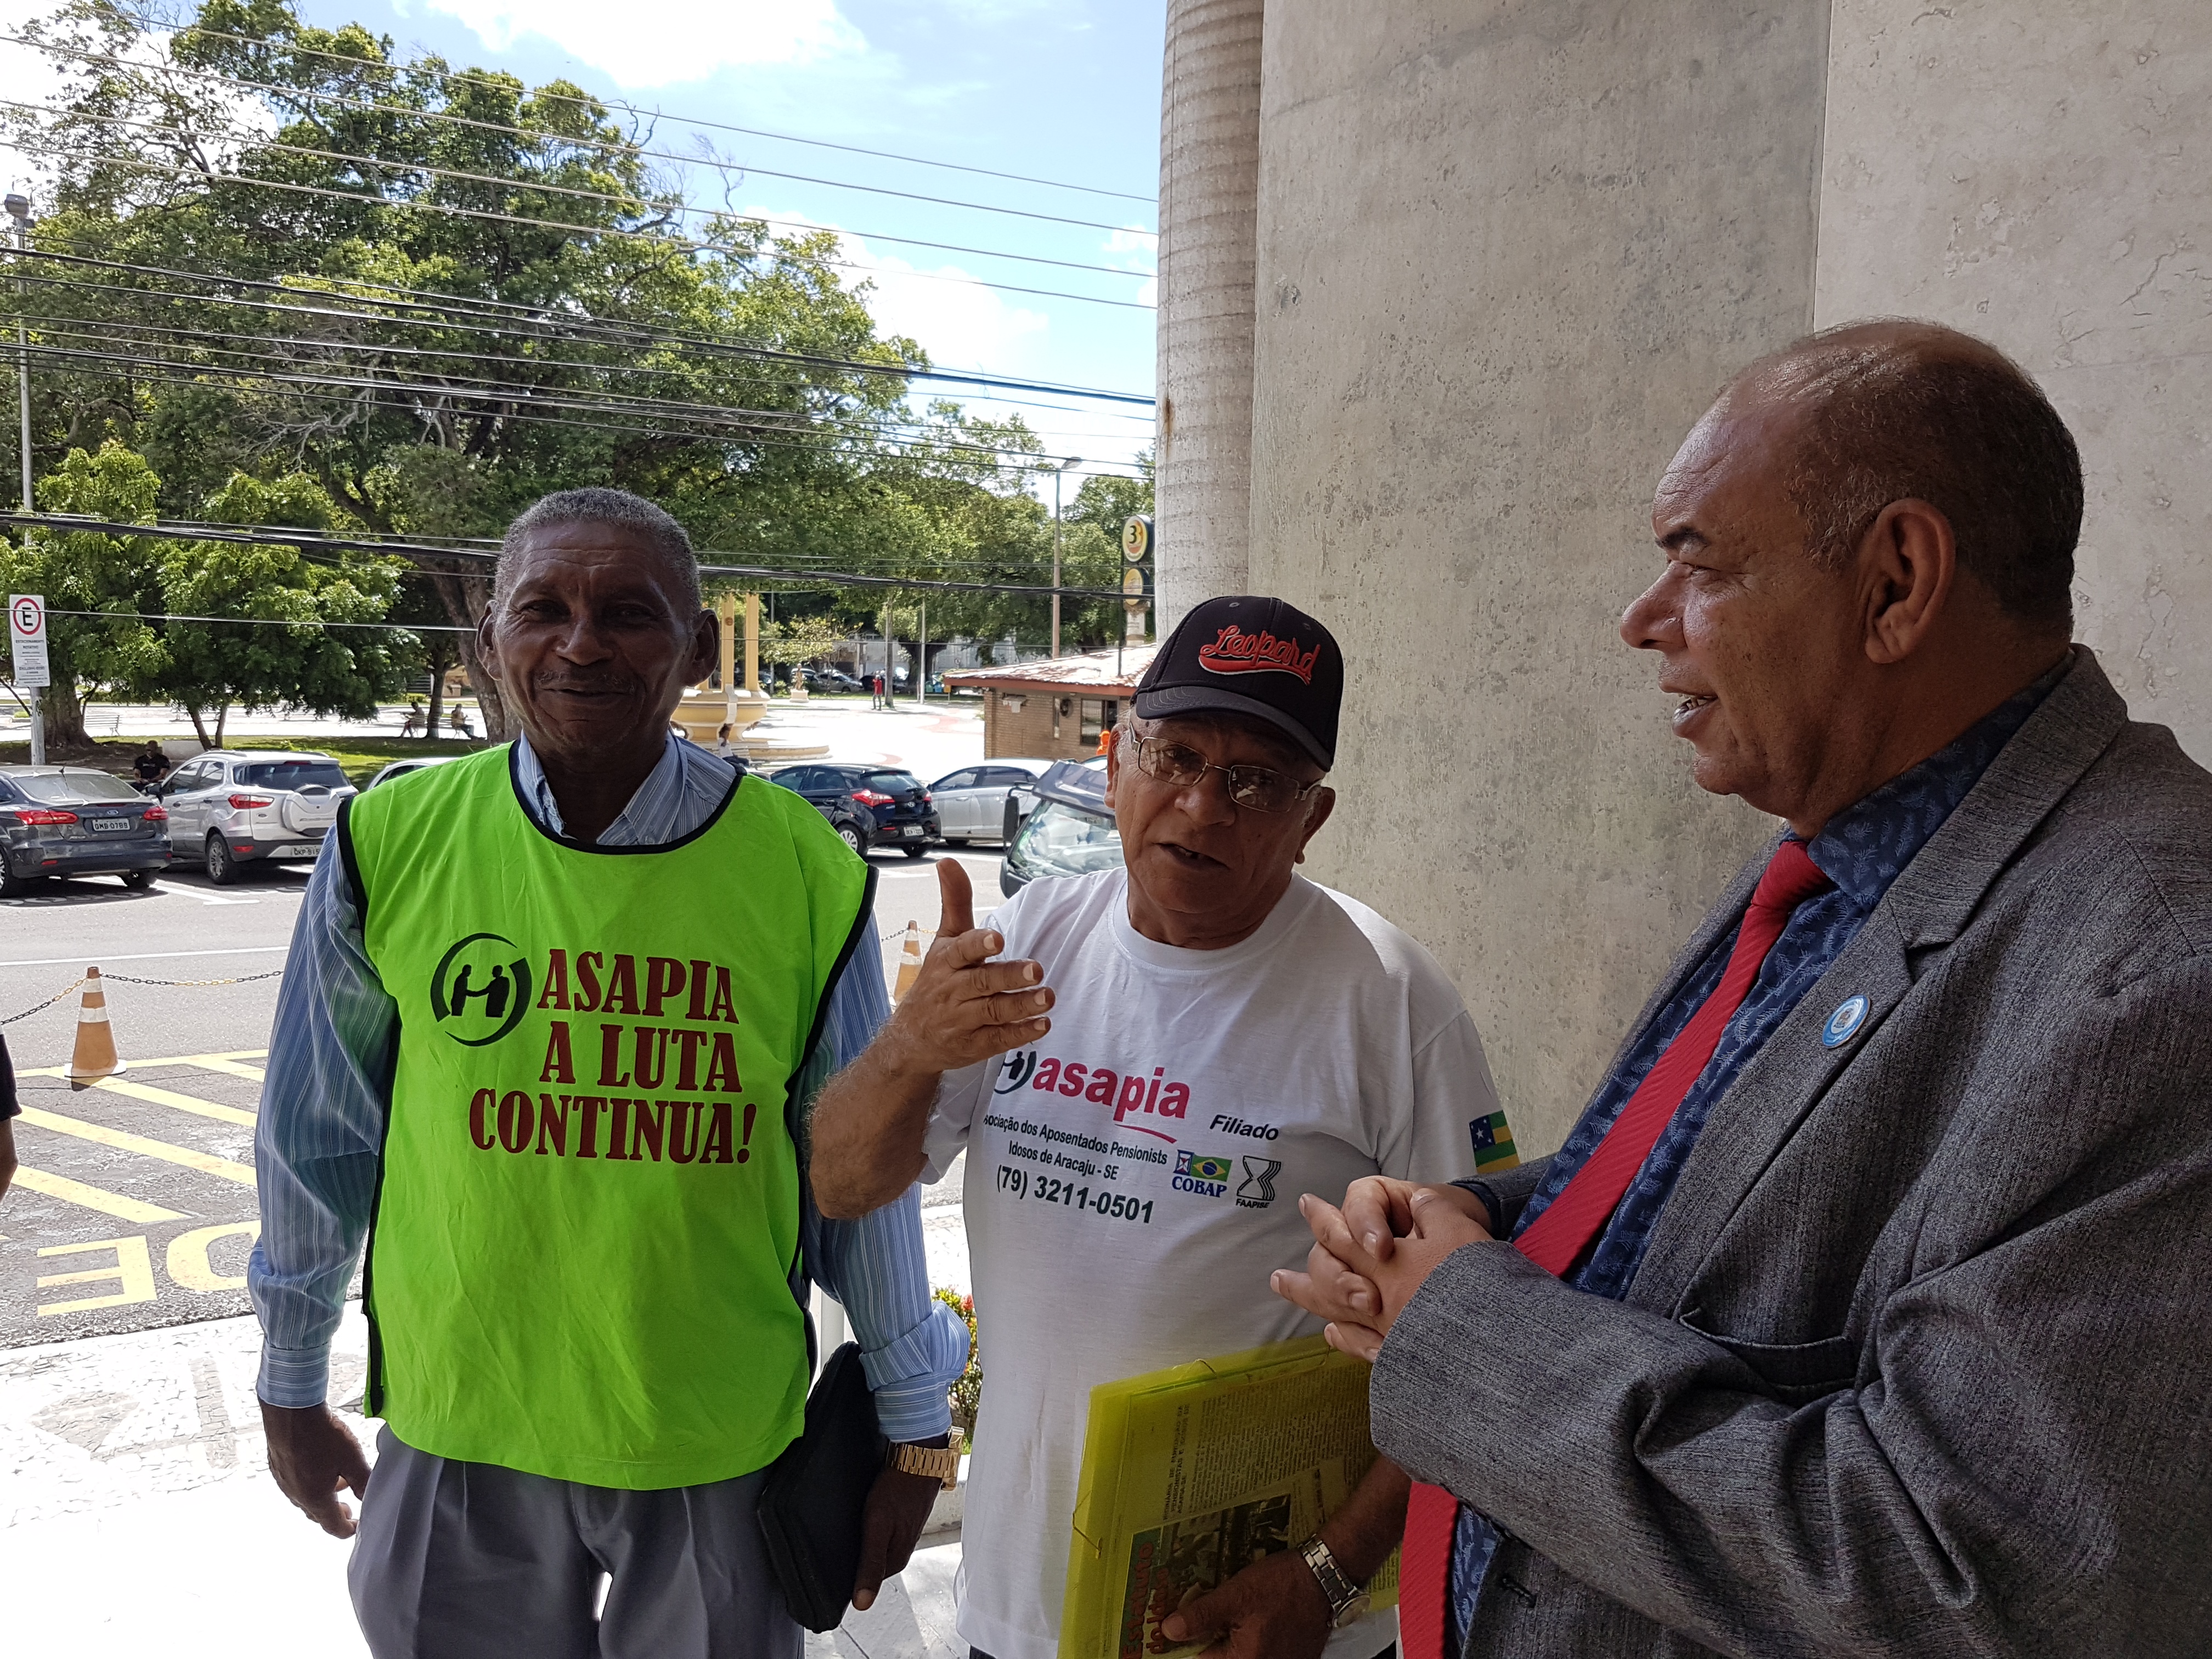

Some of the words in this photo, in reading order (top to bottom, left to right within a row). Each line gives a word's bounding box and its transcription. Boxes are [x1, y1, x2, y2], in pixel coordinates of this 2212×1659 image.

[1129, 525, 1137, 544] 3
[22, 607, 33, 627] E
[1200, 625, 1321, 676] Leopard
[536, 949, 740, 1024] ASAPIA
[539, 1021, 576, 1084] A
[597, 1024, 743, 1092] LUTA
[1032, 1057, 1191, 1122] asapia
[469, 1088, 757, 1164] CONTINUA!
[1020, 1120, 1038, 1136] dos
[1040, 1124, 1108, 1153] Aposentados
[1110, 1142, 1168, 1165] Pensionists
[1210, 1114, 1279, 1141] Filiado
[1008, 1140, 1039, 1160] Idosos
[1040, 1149, 1053, 1164] de
[1053, 1152, 1096, 1177] Aracaju
[1103, 1164, 1119, 1181] SE
[996, 1164, 1029, 1200] (79)
[1033, 1175, 1154, 1224] 3211-0501
[1171, 1176, 1227, 1198] COBAP
